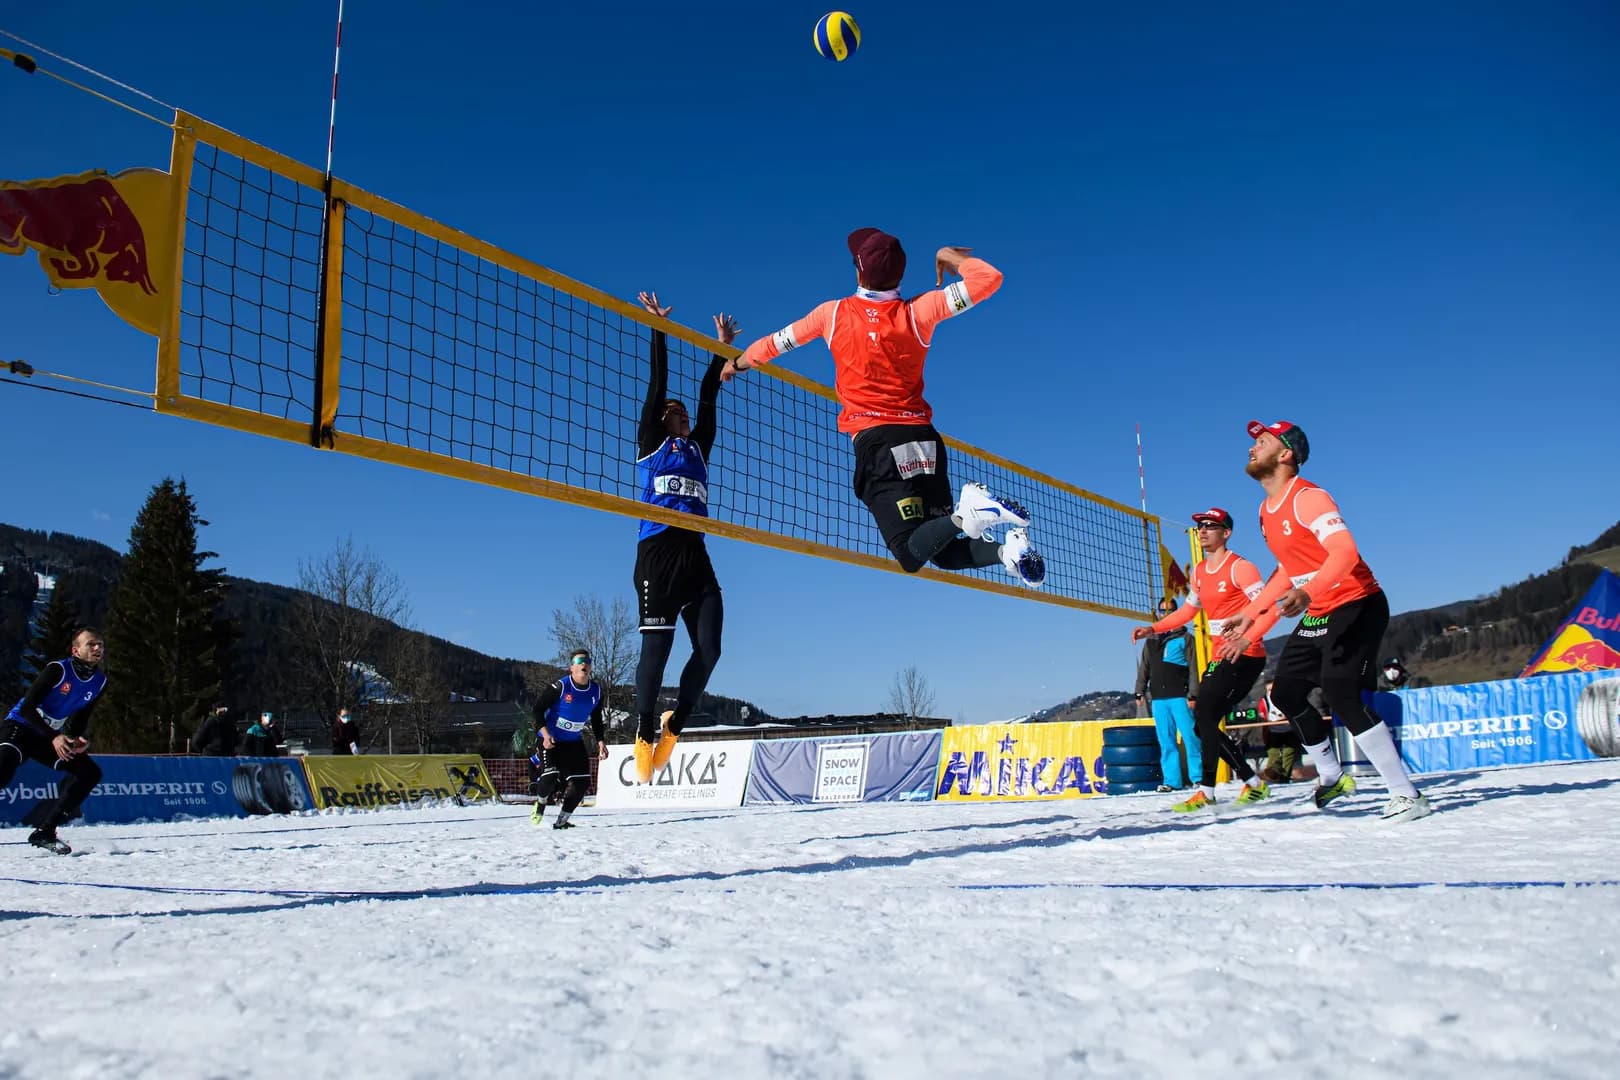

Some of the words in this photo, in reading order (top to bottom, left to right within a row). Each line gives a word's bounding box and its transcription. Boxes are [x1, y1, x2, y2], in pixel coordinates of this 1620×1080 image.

[1282, 519, 1292, 536] 3
[1217, 581, 1227, 593] 2
[83, 691, 93, 701] 3
[1388, 714, 1533, 741] EMPERIT
[1471, 739, 1496, 749] Seit
[1501, 735, 1537, 747] 1906.
[825, 759, 860, 769] SNOW
[823, 775, 858, 786] SPACE
[90, 782, 204, 796] SEMPERIT
[320, 782, 450, 807] Raiffeisen
[635, 789, 647, 799] WE
[648, 789, 677, 799] CREATE
[163, 798, 181, 806] Seit
